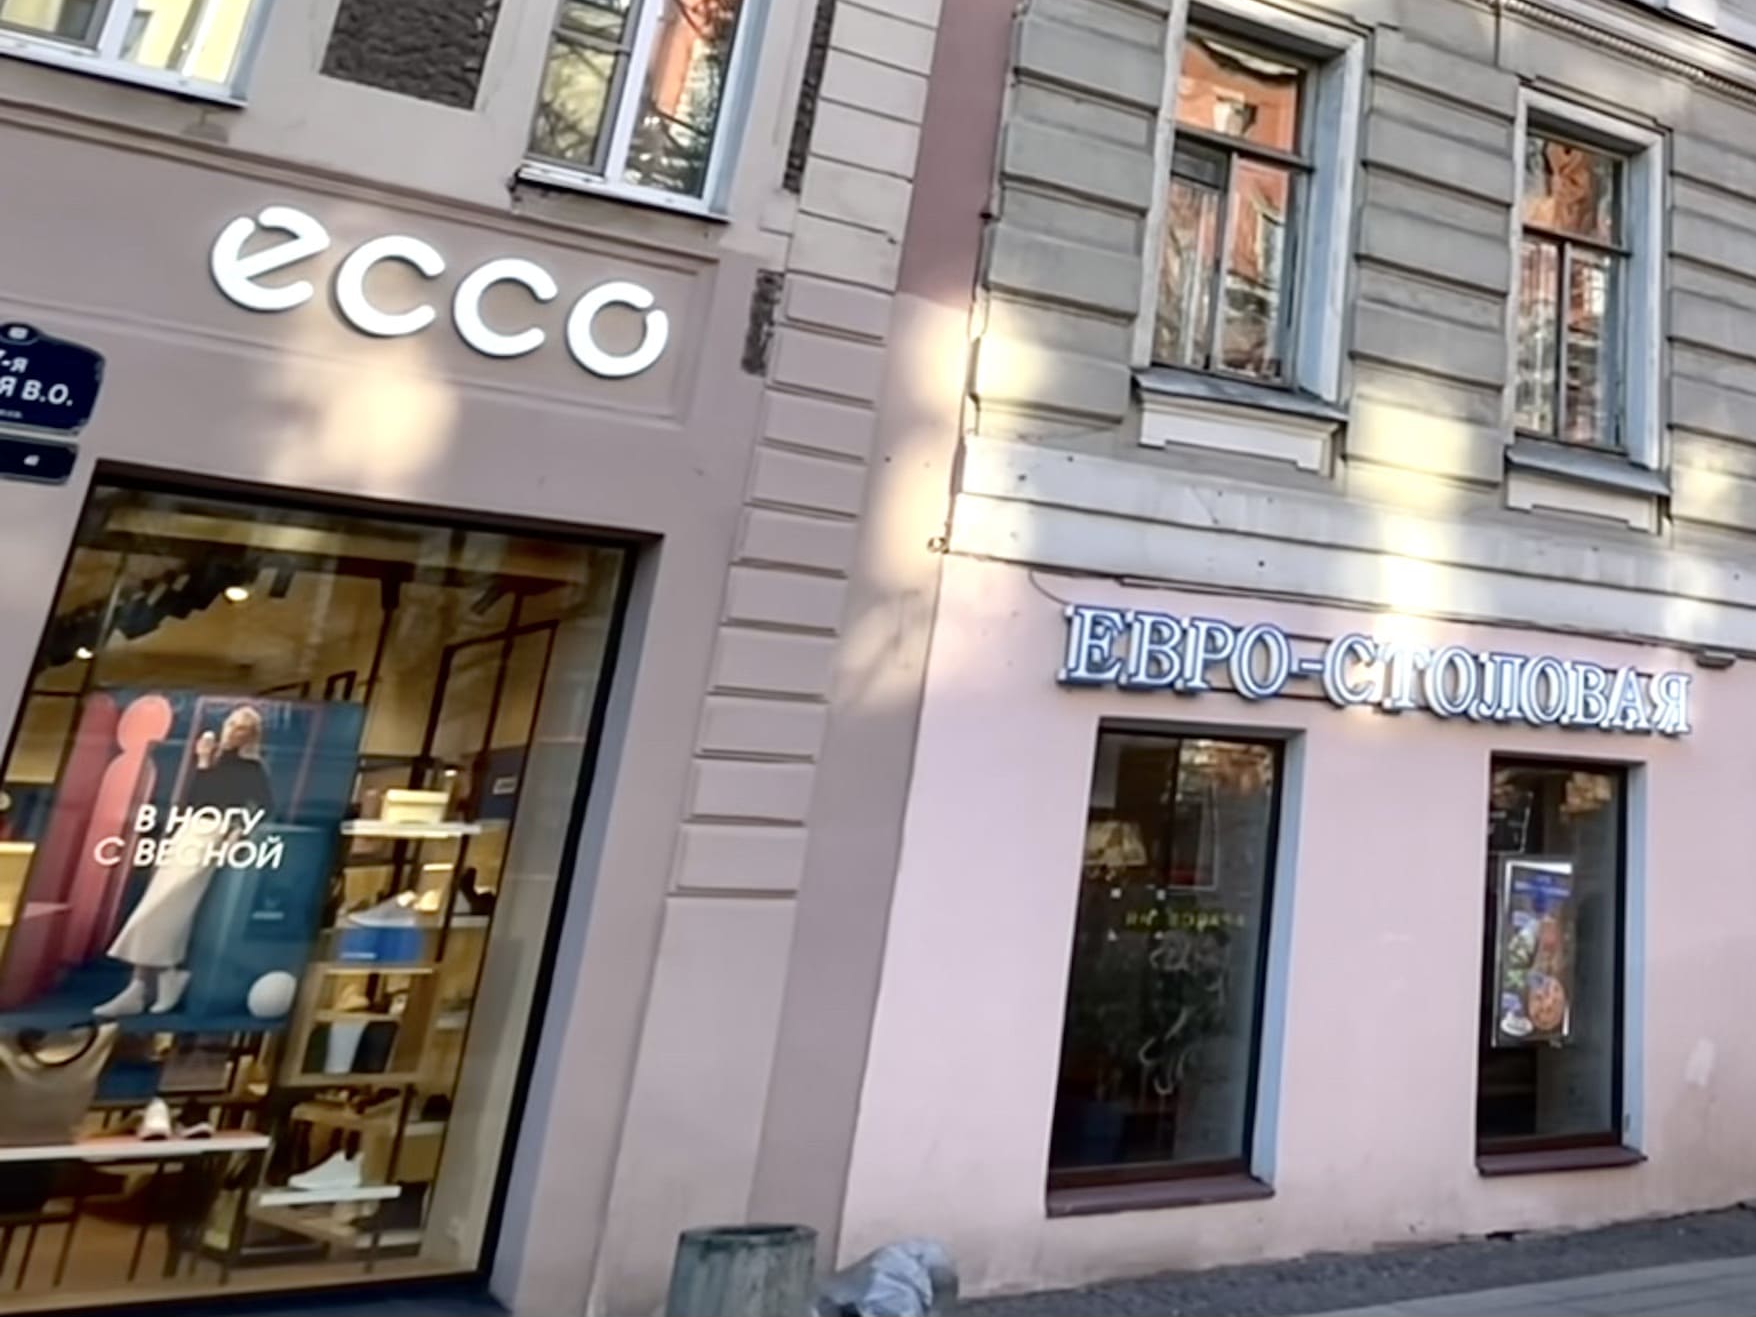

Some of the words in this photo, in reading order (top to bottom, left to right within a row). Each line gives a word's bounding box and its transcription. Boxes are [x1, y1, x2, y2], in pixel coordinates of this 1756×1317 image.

[210, 206, 669, 378] ecco
[21, 379, 73, 407] В.О.
[1057, 603, 1694, 734] ЕВРО-СТОЛОВАЯ
[134, 803, 158, 833] В
[165, 805, 266, 835] НОГУ
[132, 836, 285, 870] ВЕСНОЙ
